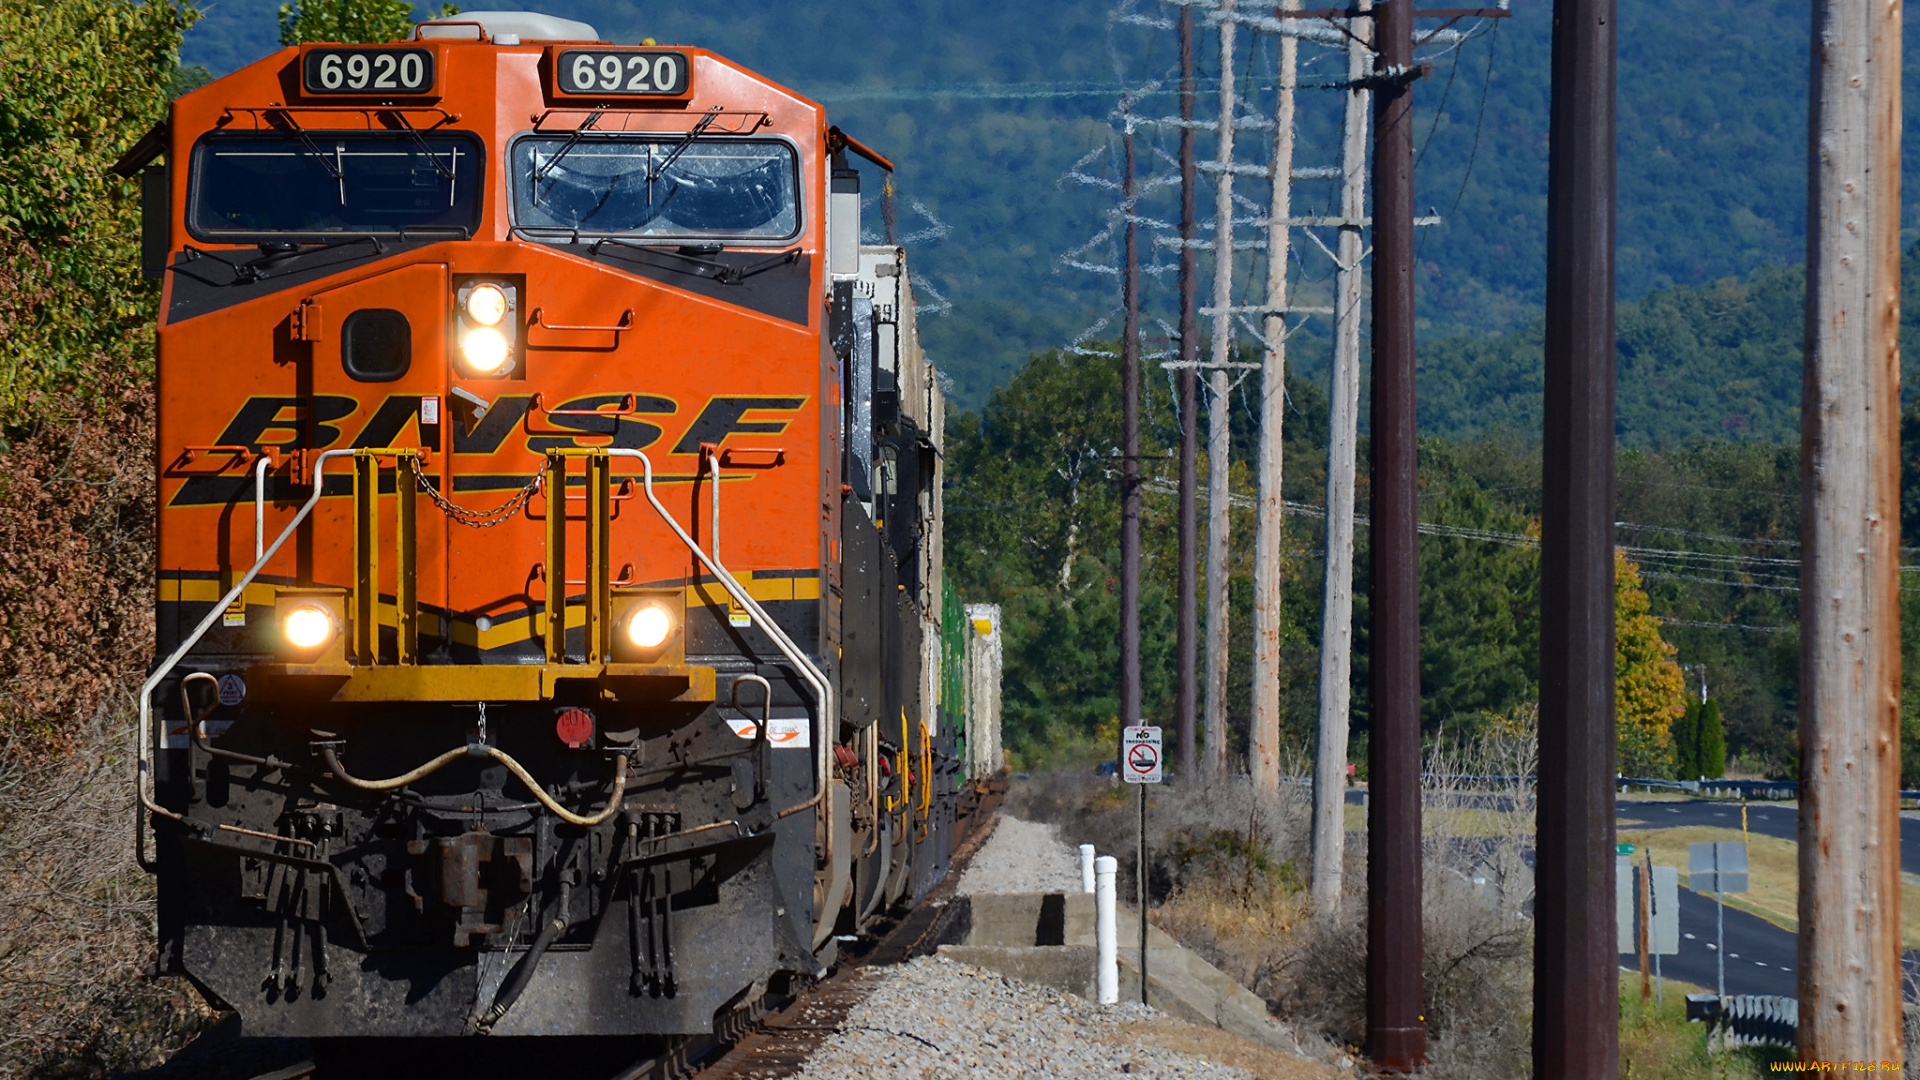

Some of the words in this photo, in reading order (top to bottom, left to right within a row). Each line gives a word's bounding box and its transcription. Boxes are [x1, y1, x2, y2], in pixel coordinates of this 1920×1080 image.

[320, 53, 424, 89] 6920
[572, 54, 678, 91] 6920
[206, 393, 811, 456] BNSF
